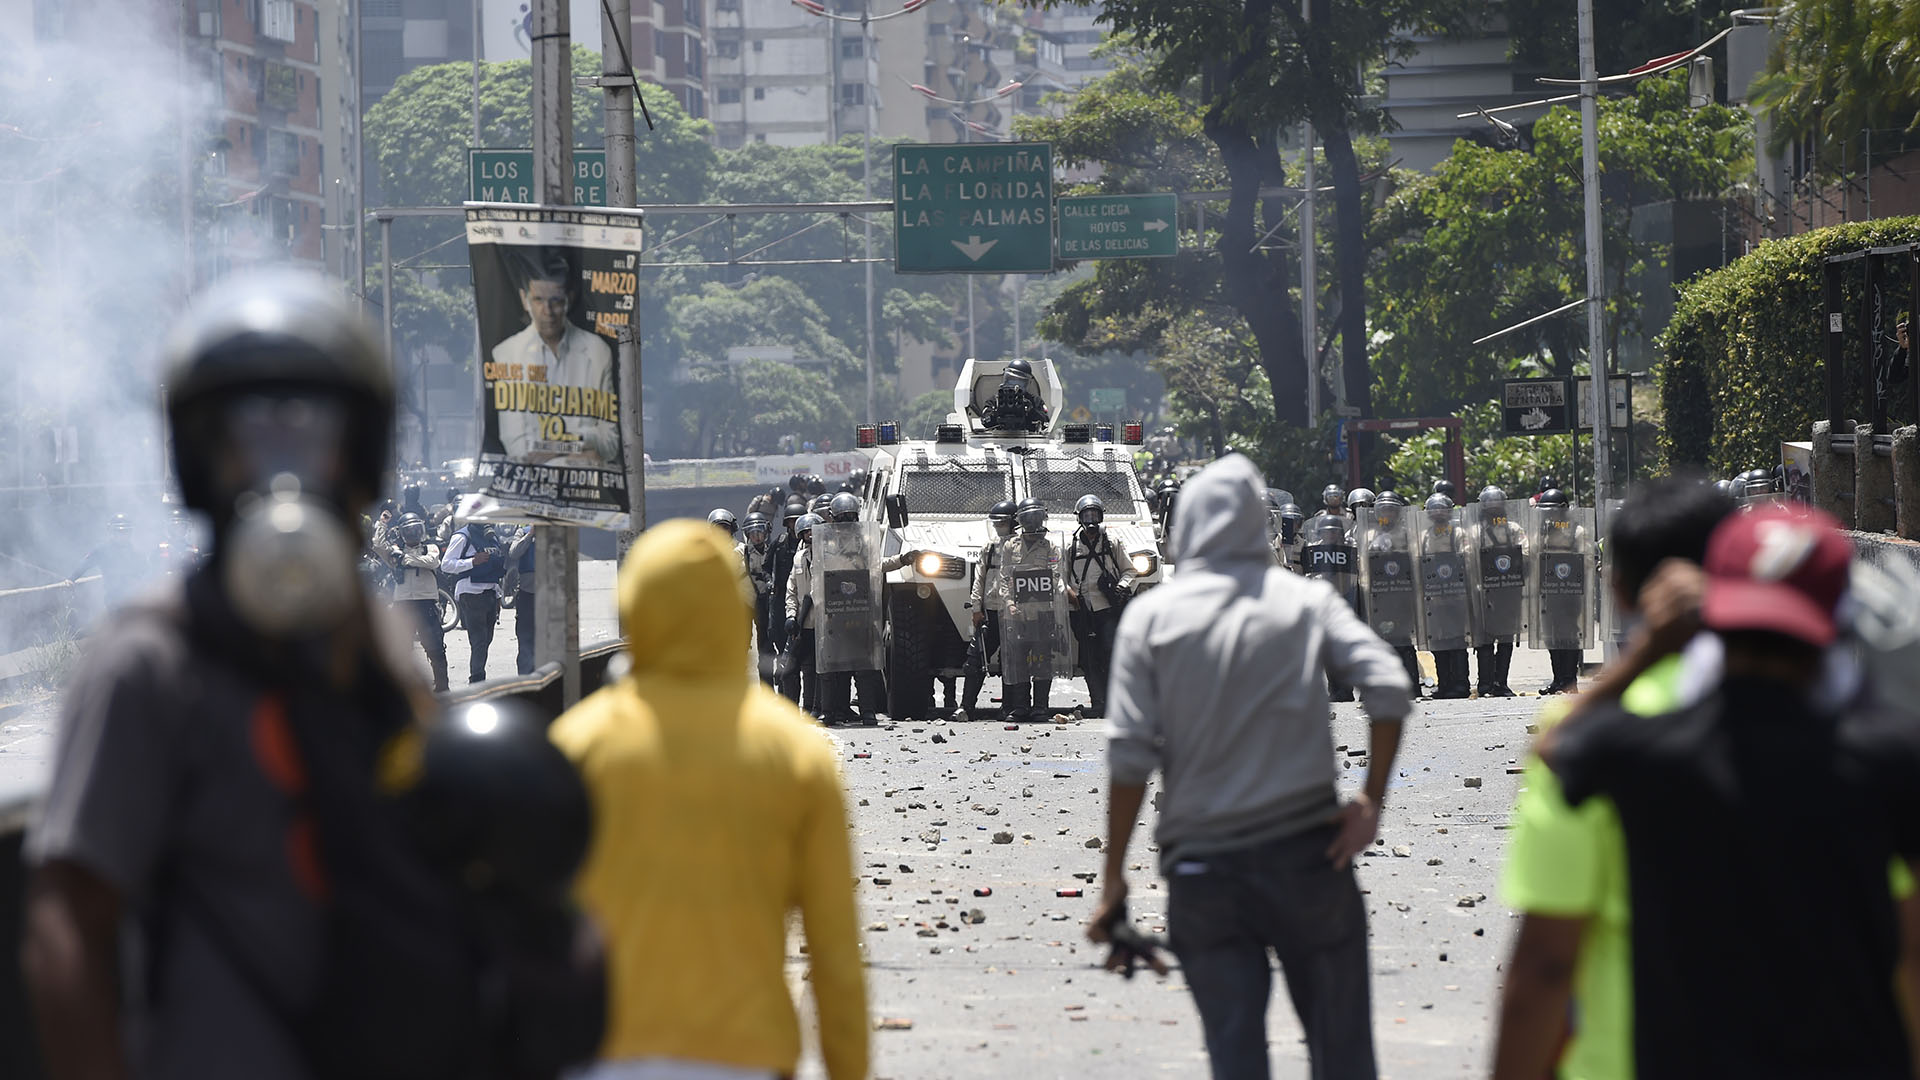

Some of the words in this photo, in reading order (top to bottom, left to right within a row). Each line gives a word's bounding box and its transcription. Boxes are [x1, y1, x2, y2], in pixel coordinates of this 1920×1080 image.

[481, 161, 518, 179] LOS
[902, 157, 930, 175] LA
[944, 151, 1045, 174] CAMPIÑA
[902, 183, 932, 201] LA
[945, 181, 1046, 200] FLORIDA
[902, 209, 945, 227] LAS
[960, 207, 1046, 227] PALMAS
[1064, 205, 1097, 218] CALLE
[1101, 204, 1130, 217] CIEGA
[1090, 221, 1127, 233] HOYOS
[1065, 240, 1079, 252] DE
[1081, 239, 1102, 251] LAS
[1105, 238, 1149, 250] DELICIAS
[582, 270, 592, 280] DE
[591, 271, 636, 295] MARZO
[586, 311, 596, 320] DE
[484, 361, 523, 381] CARLOS
[494, 381, 619, 422] DIVORCIARME
[502, 464, 513, 477] Y
[569, 471, 599, 487] DOM
[602, 472, 625, 489] 6PM
[1313, 551, 1347, 565] PNB
[1016, 577, 1052, 592] PNB
